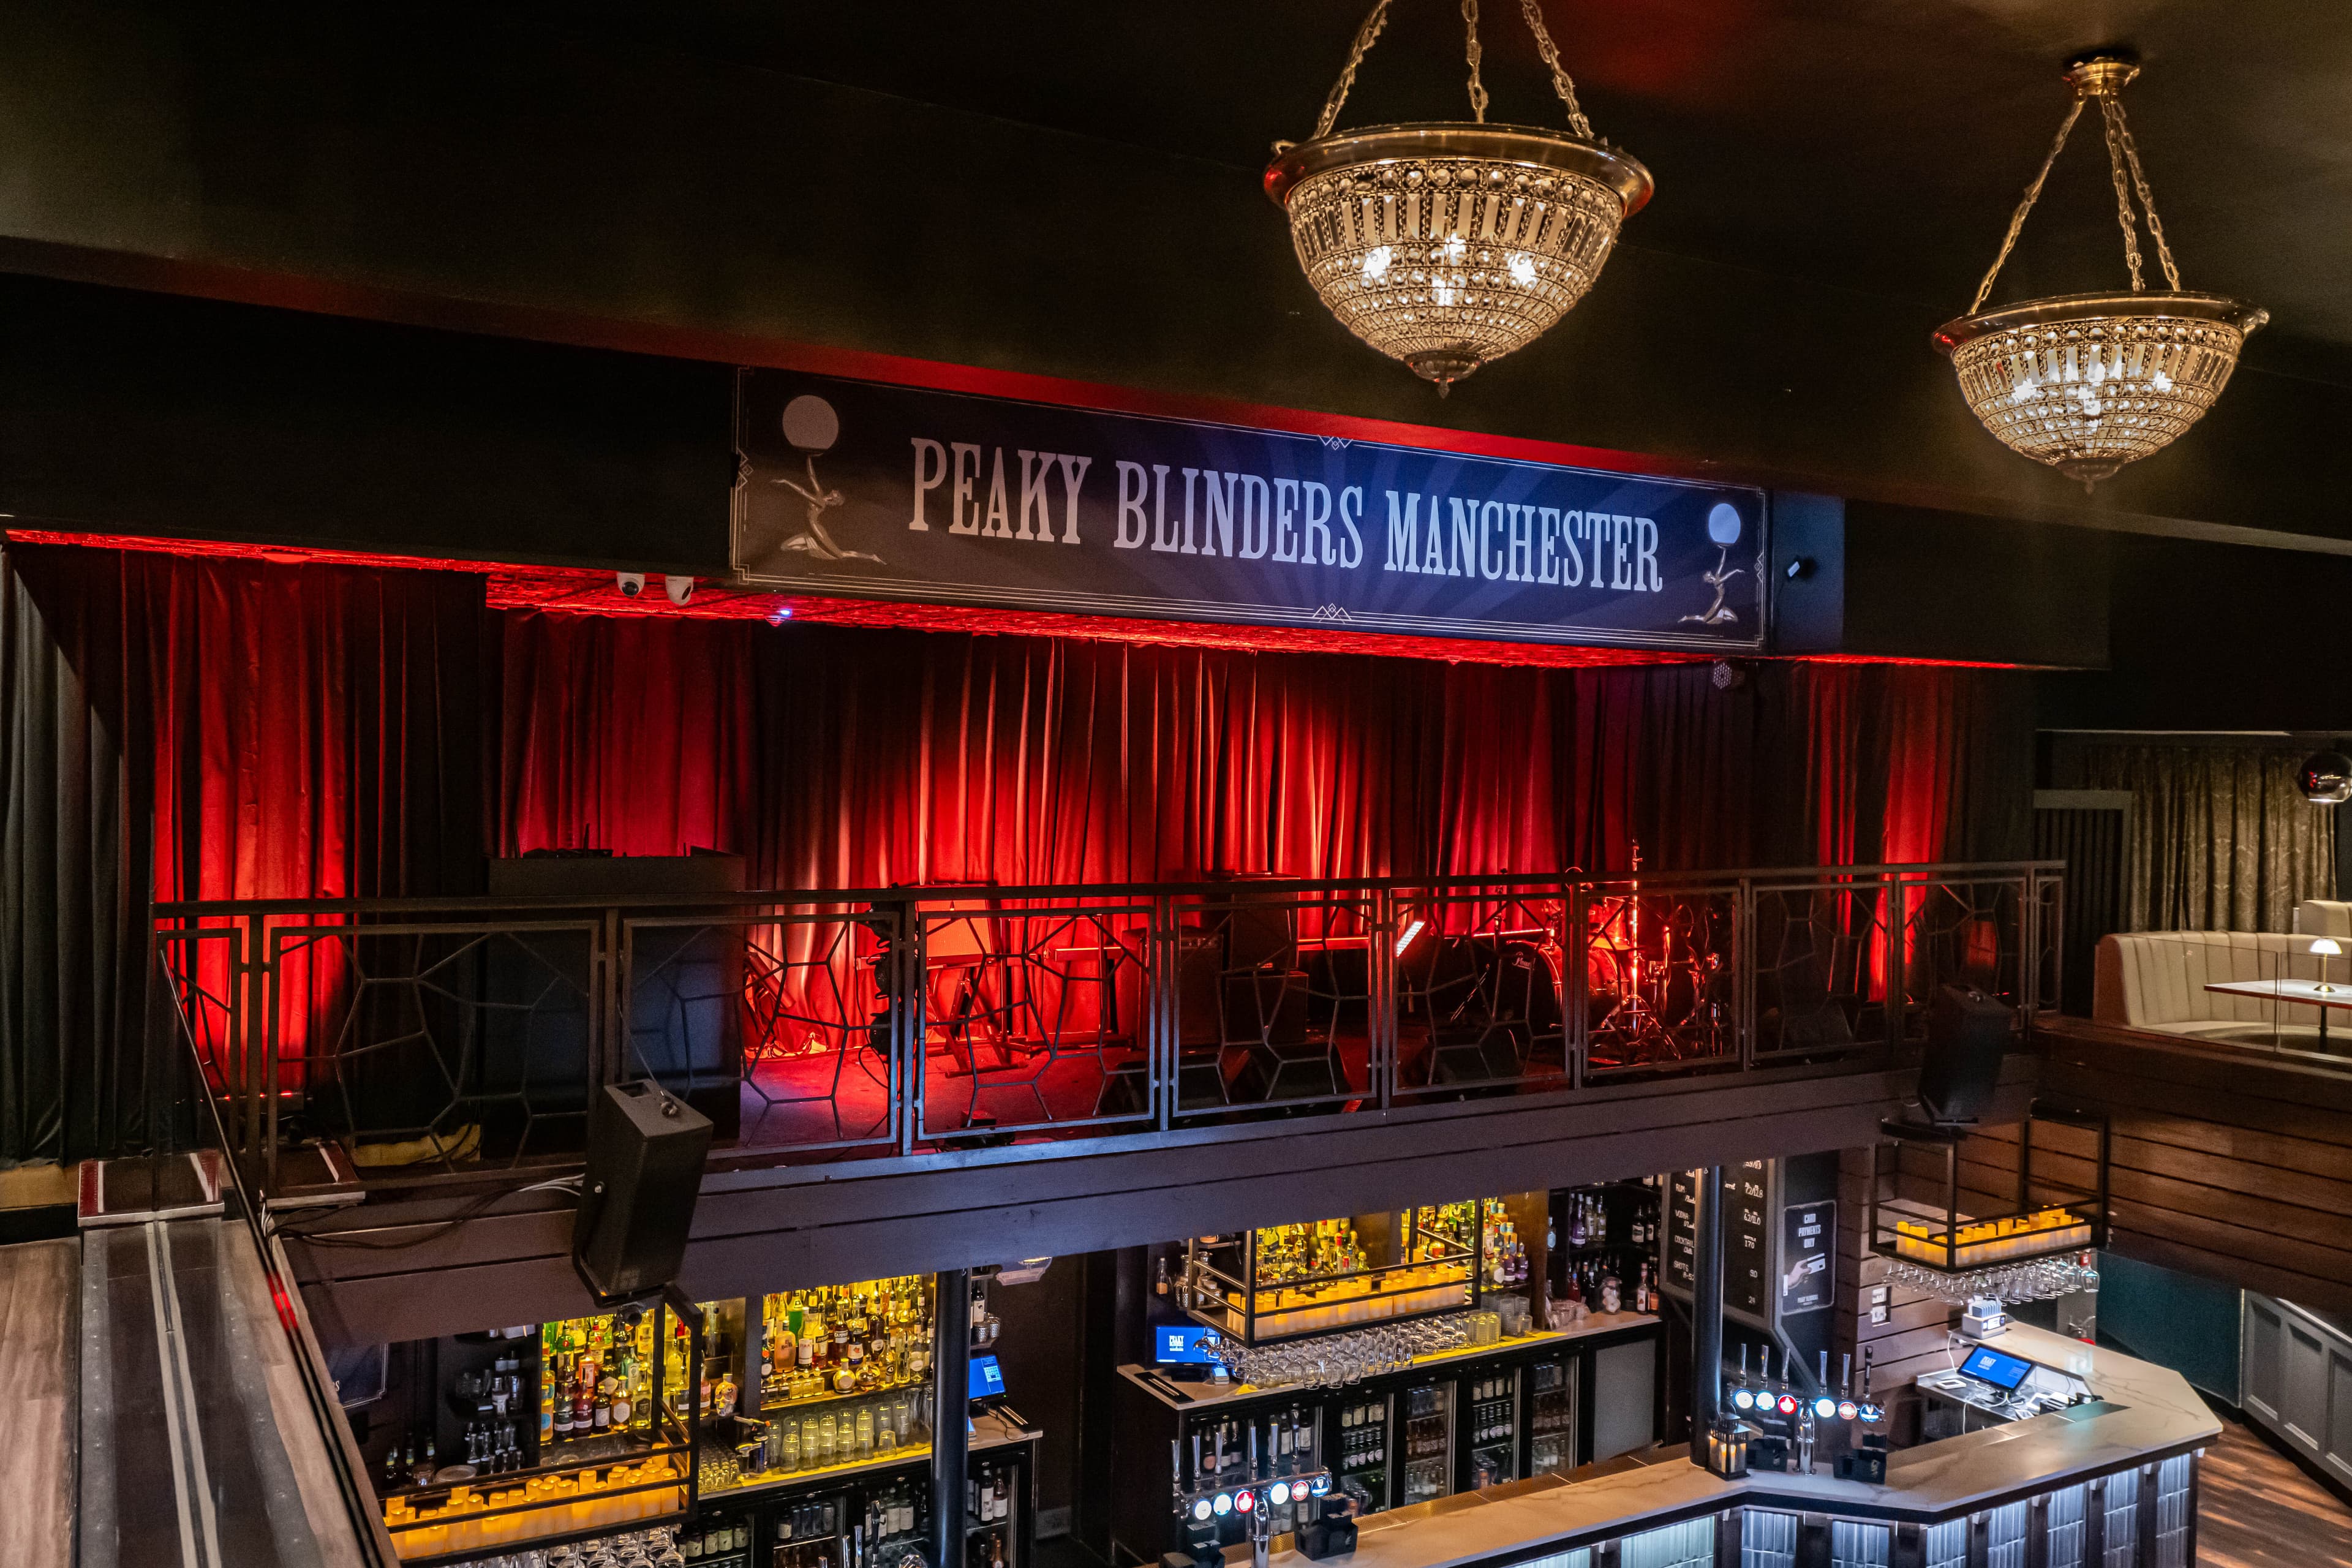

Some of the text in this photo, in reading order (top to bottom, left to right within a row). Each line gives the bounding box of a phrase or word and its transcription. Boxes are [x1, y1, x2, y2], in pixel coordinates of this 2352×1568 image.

[909, 437, 1663, 592] PEAKY BLINDERS MANCHESTER
